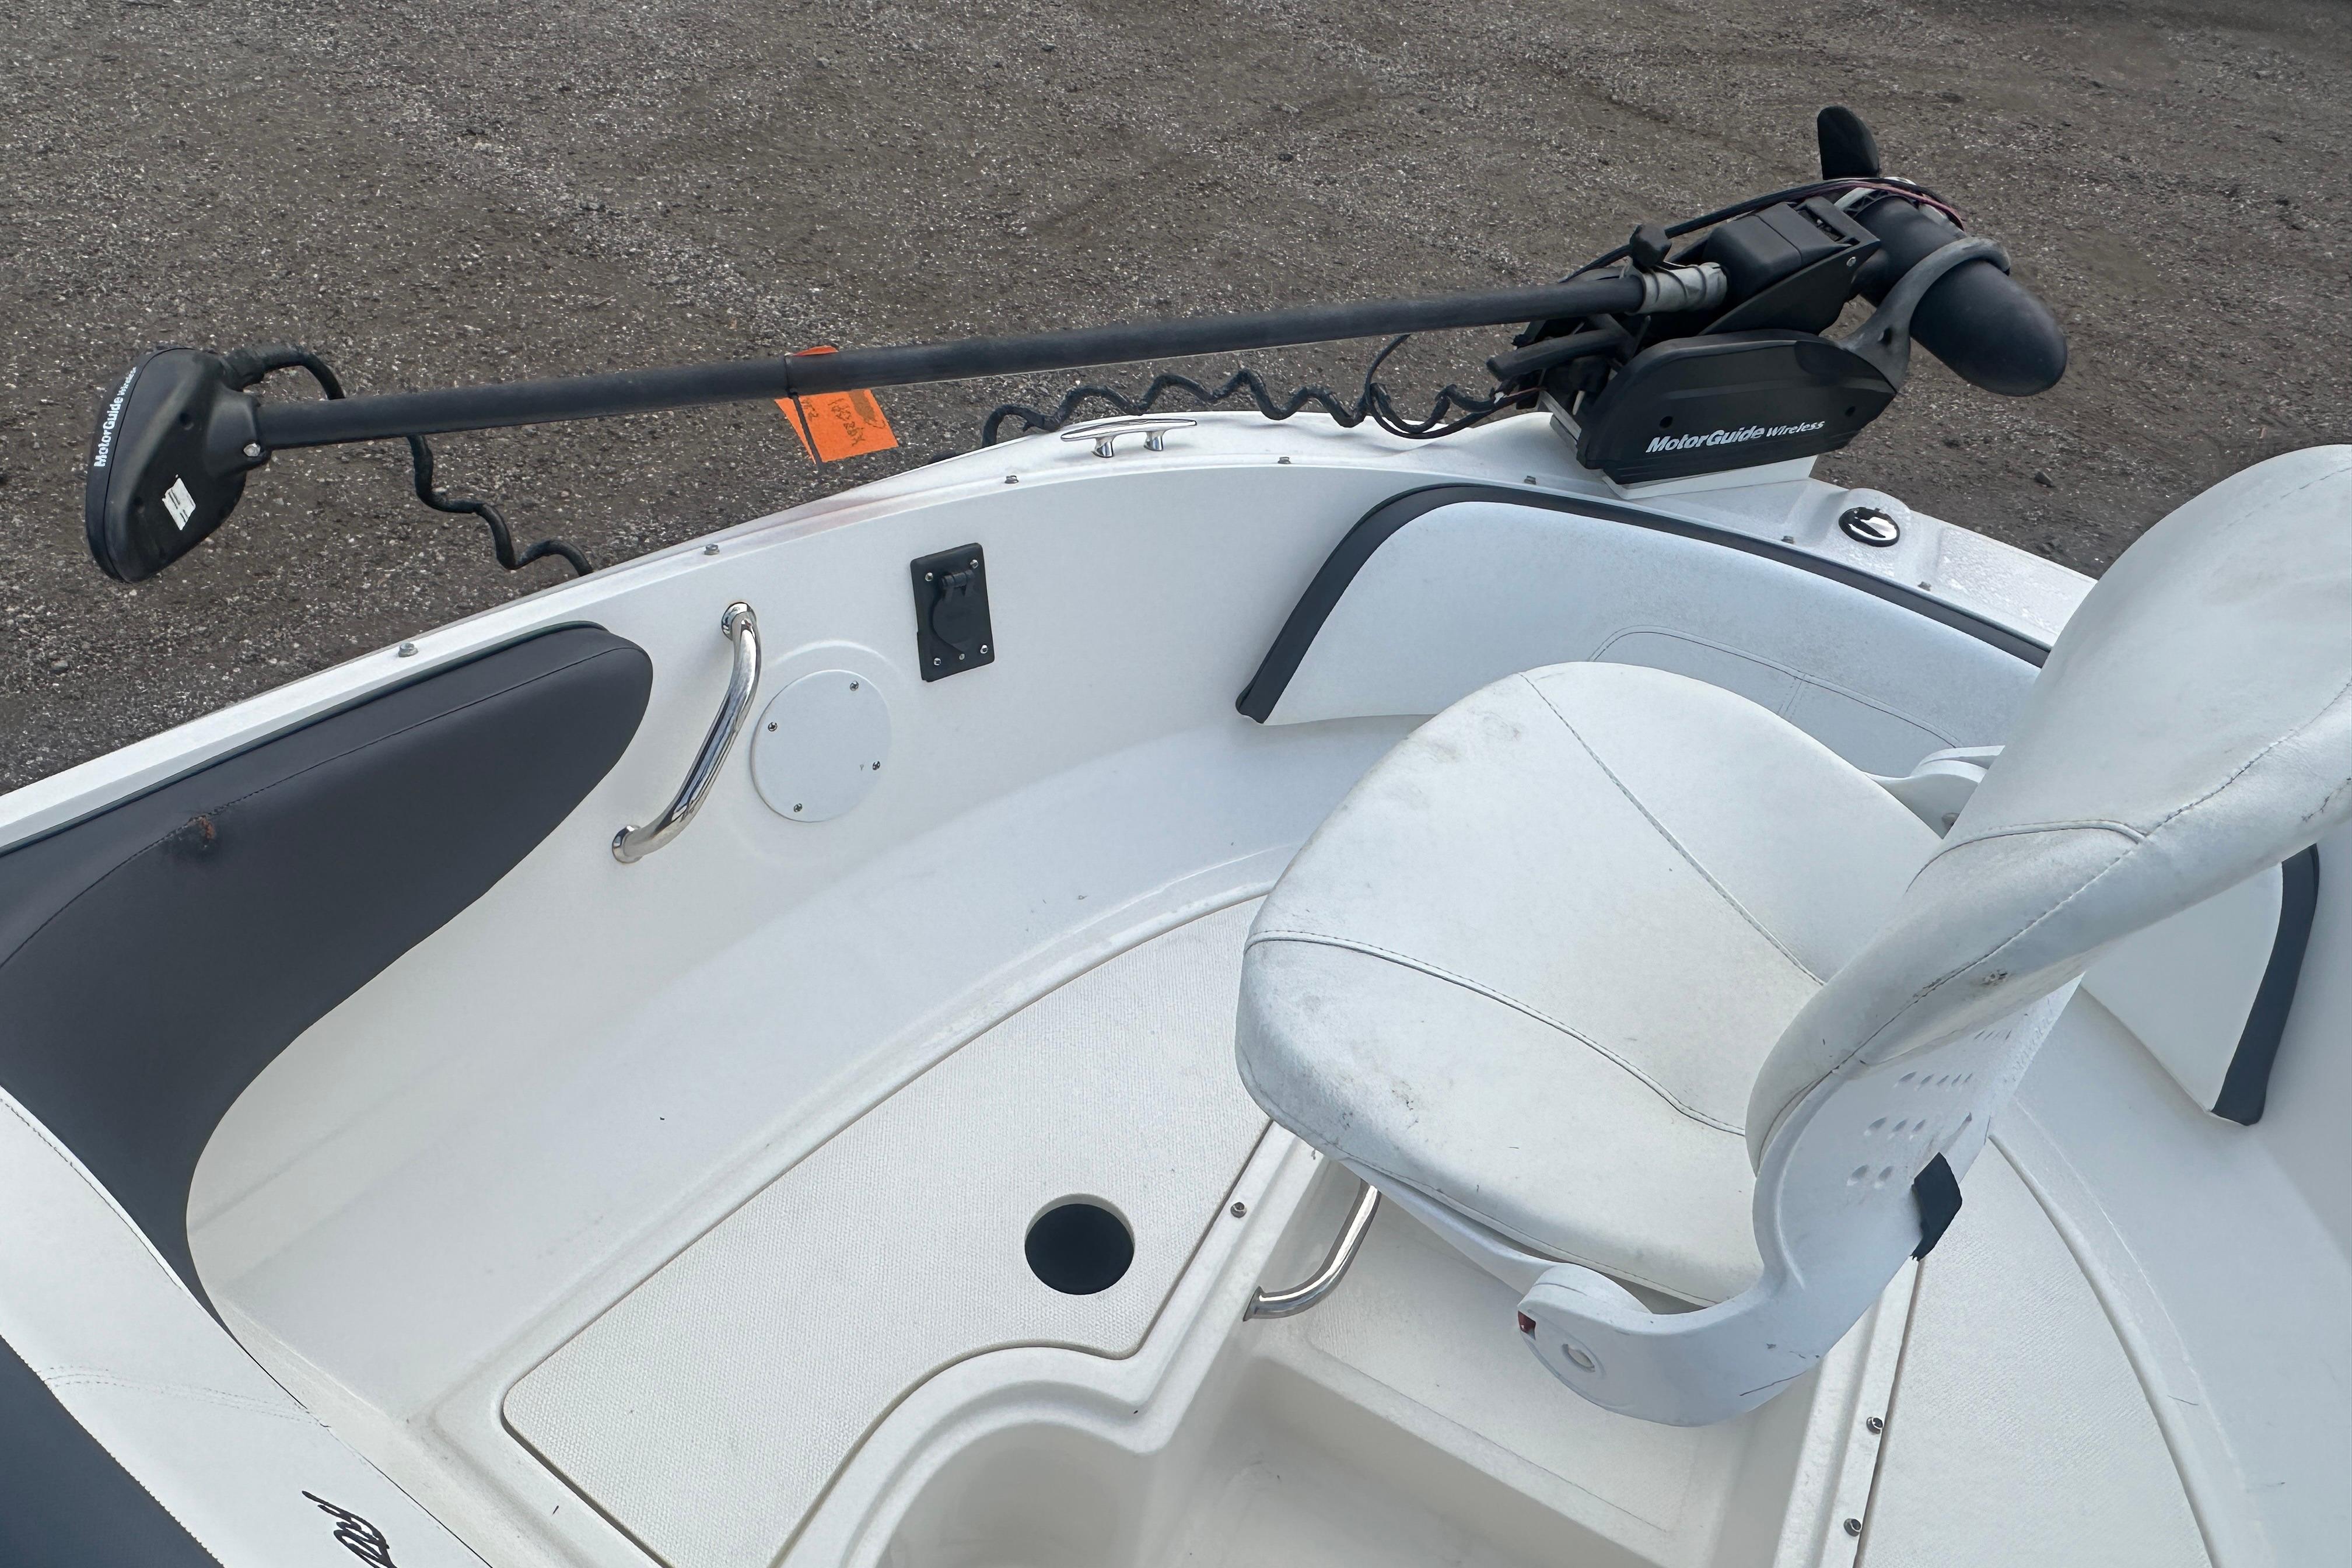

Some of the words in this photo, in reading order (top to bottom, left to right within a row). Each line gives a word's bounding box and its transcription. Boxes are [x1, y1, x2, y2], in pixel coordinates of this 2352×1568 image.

[94, 397, 124, 467] MotorGuide
[1646, 425, 1765, 453] MotorGuide
[1766, 421, 1825, 437] Wireless
